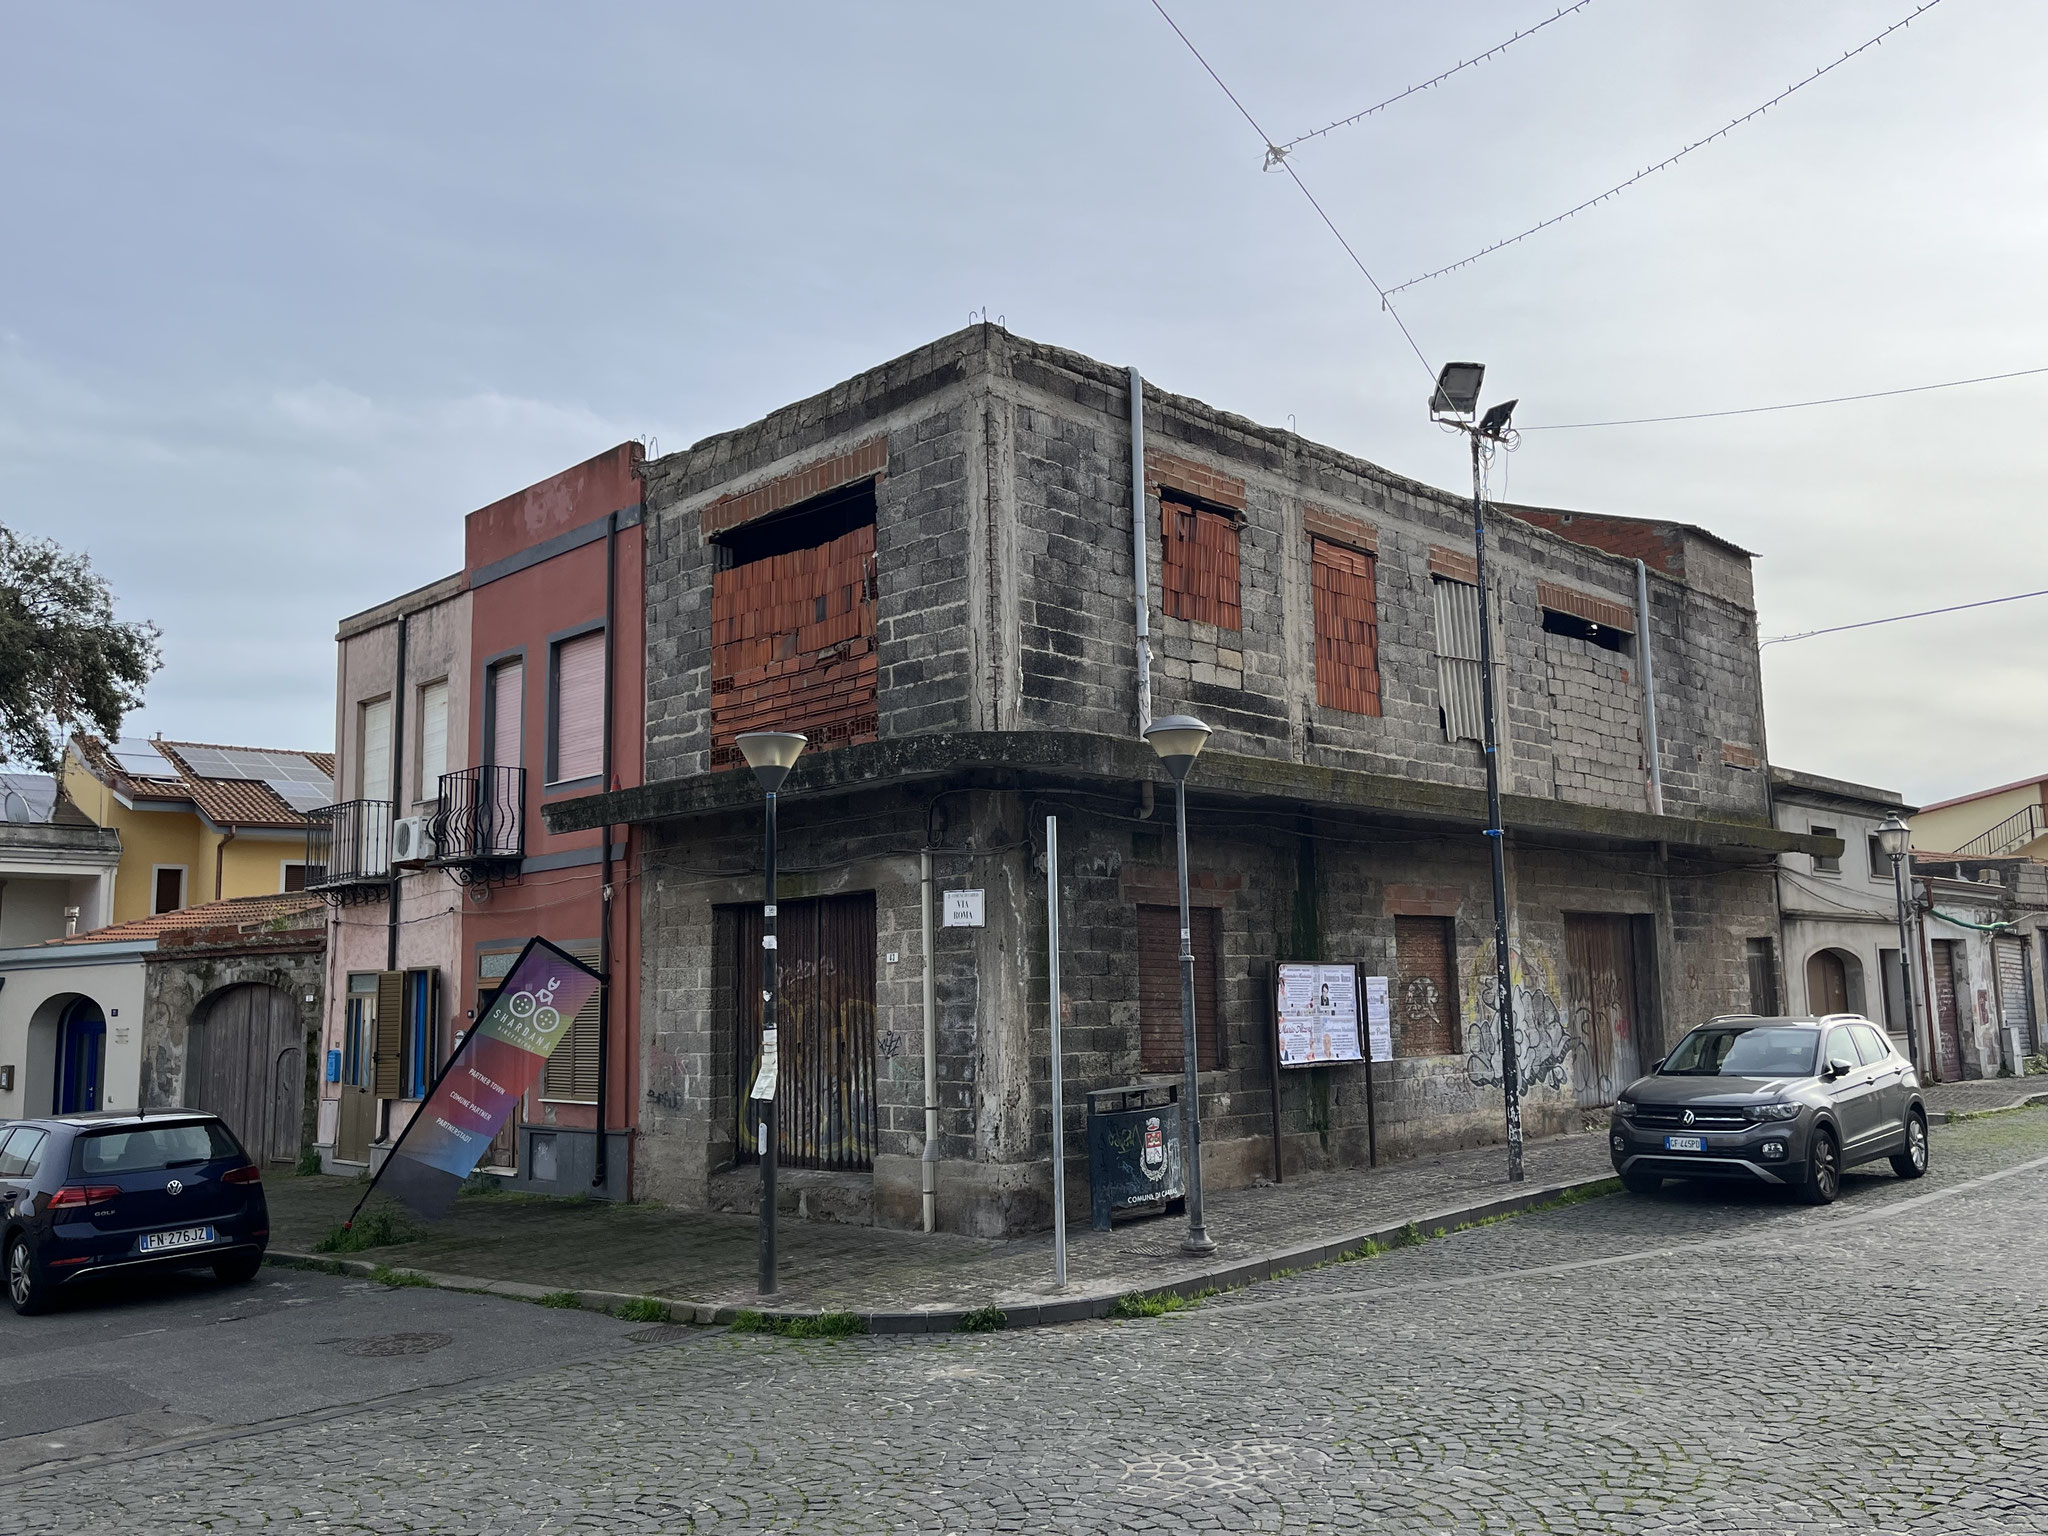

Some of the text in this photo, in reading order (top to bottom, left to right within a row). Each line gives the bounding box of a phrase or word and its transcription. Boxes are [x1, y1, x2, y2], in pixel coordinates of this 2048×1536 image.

[957, 900, 969, 908] VIA
[953, 911, 973, 919] ROMA
[493, 1009, 551, 1051] SHARDANA
[468, 1068, 506, 1096] PARTNER TOWN
[449, 1090, 492, 1121] COMUNE PARTNER
[435, 1117, 473, 1144] PARTNERSTADT
[1127, 1194, 1154, 1203] COMUNE
[94, 1209, 116, 1217] GOLF
[149, 1228, 205, 1247] FN 276JZ
